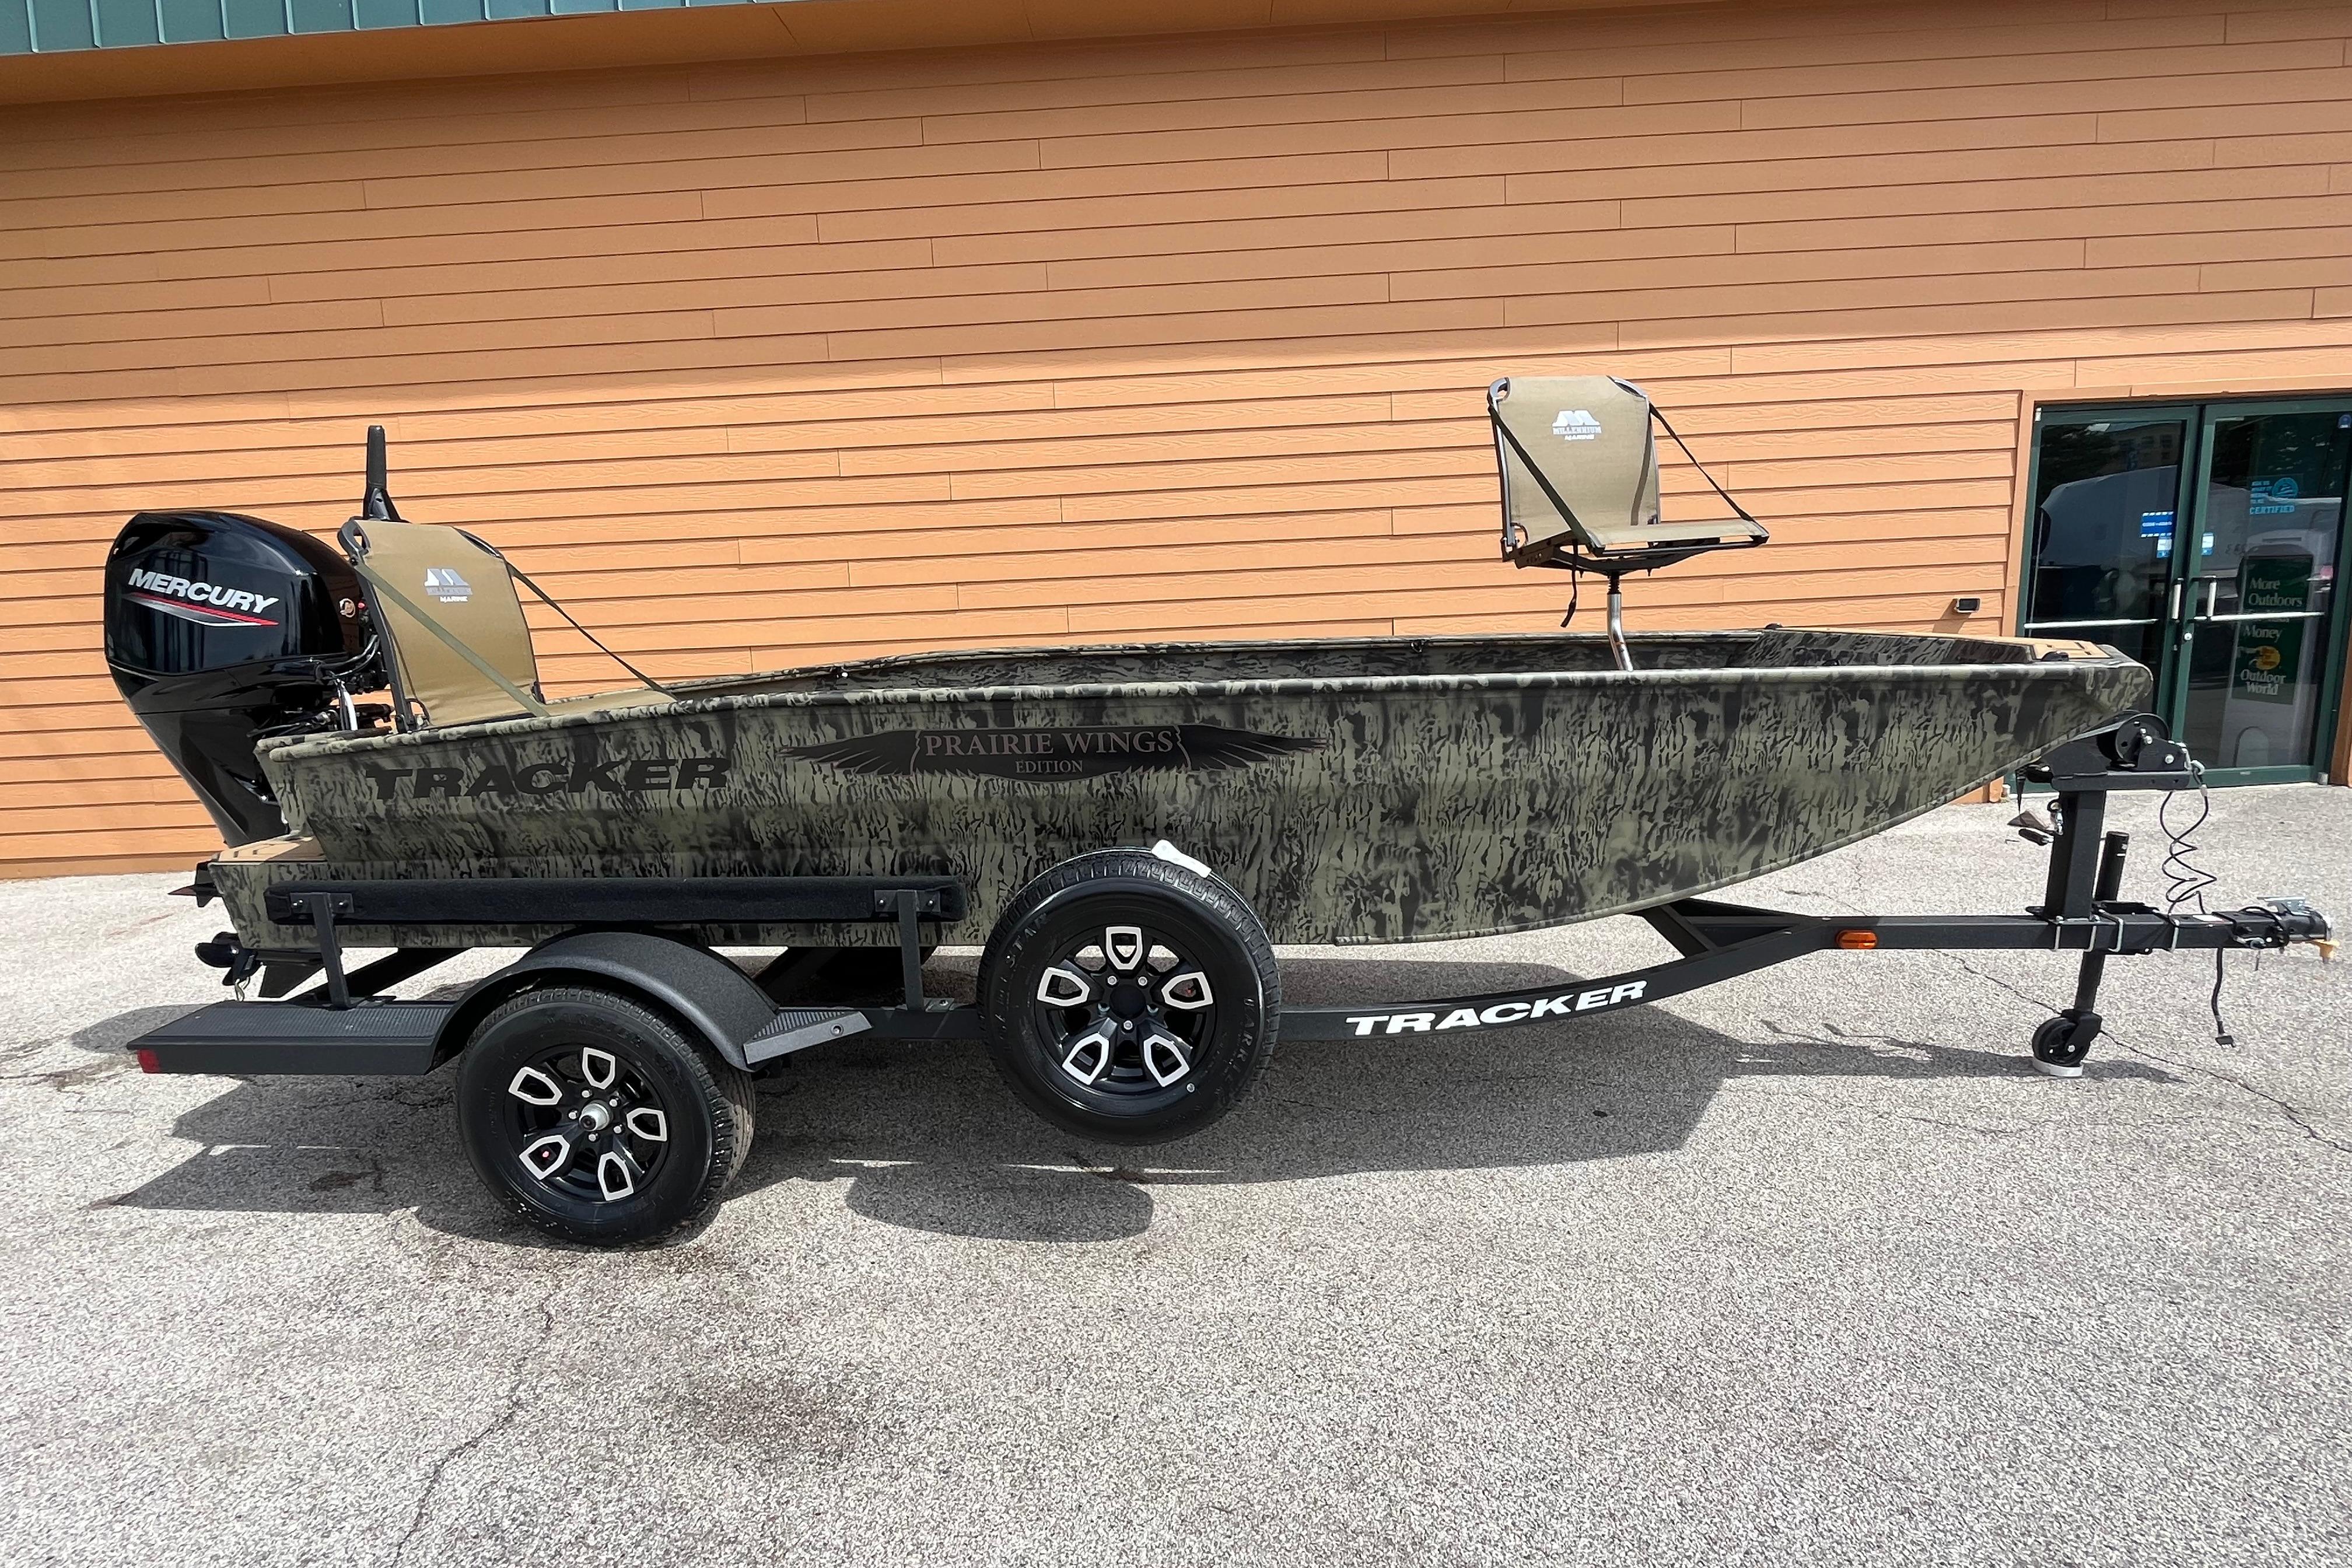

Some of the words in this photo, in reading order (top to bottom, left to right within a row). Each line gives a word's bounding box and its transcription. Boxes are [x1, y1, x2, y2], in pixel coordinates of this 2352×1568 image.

[2250, 505, 2295, 514] CERTIFIED
[128, 568, 279, 614] MERCURY
[2250, 578, 2280, 590] More
[2249, 593, 2303, 606] Outdoors
[2242, 625, 2283, 643] Money
[2241, 669, 2286, 684] Outdoor
[2245, 681, 2278, 695] World
[924, 733, 1054, 756] PRAIRIE
[1062, 730, 1173, 754] WINGS
[1016, 760, 1083, 774] EDITION
[365, 758, 731, 800] TRACKER
[1346, 980, 1647, 1036] TRACKER
